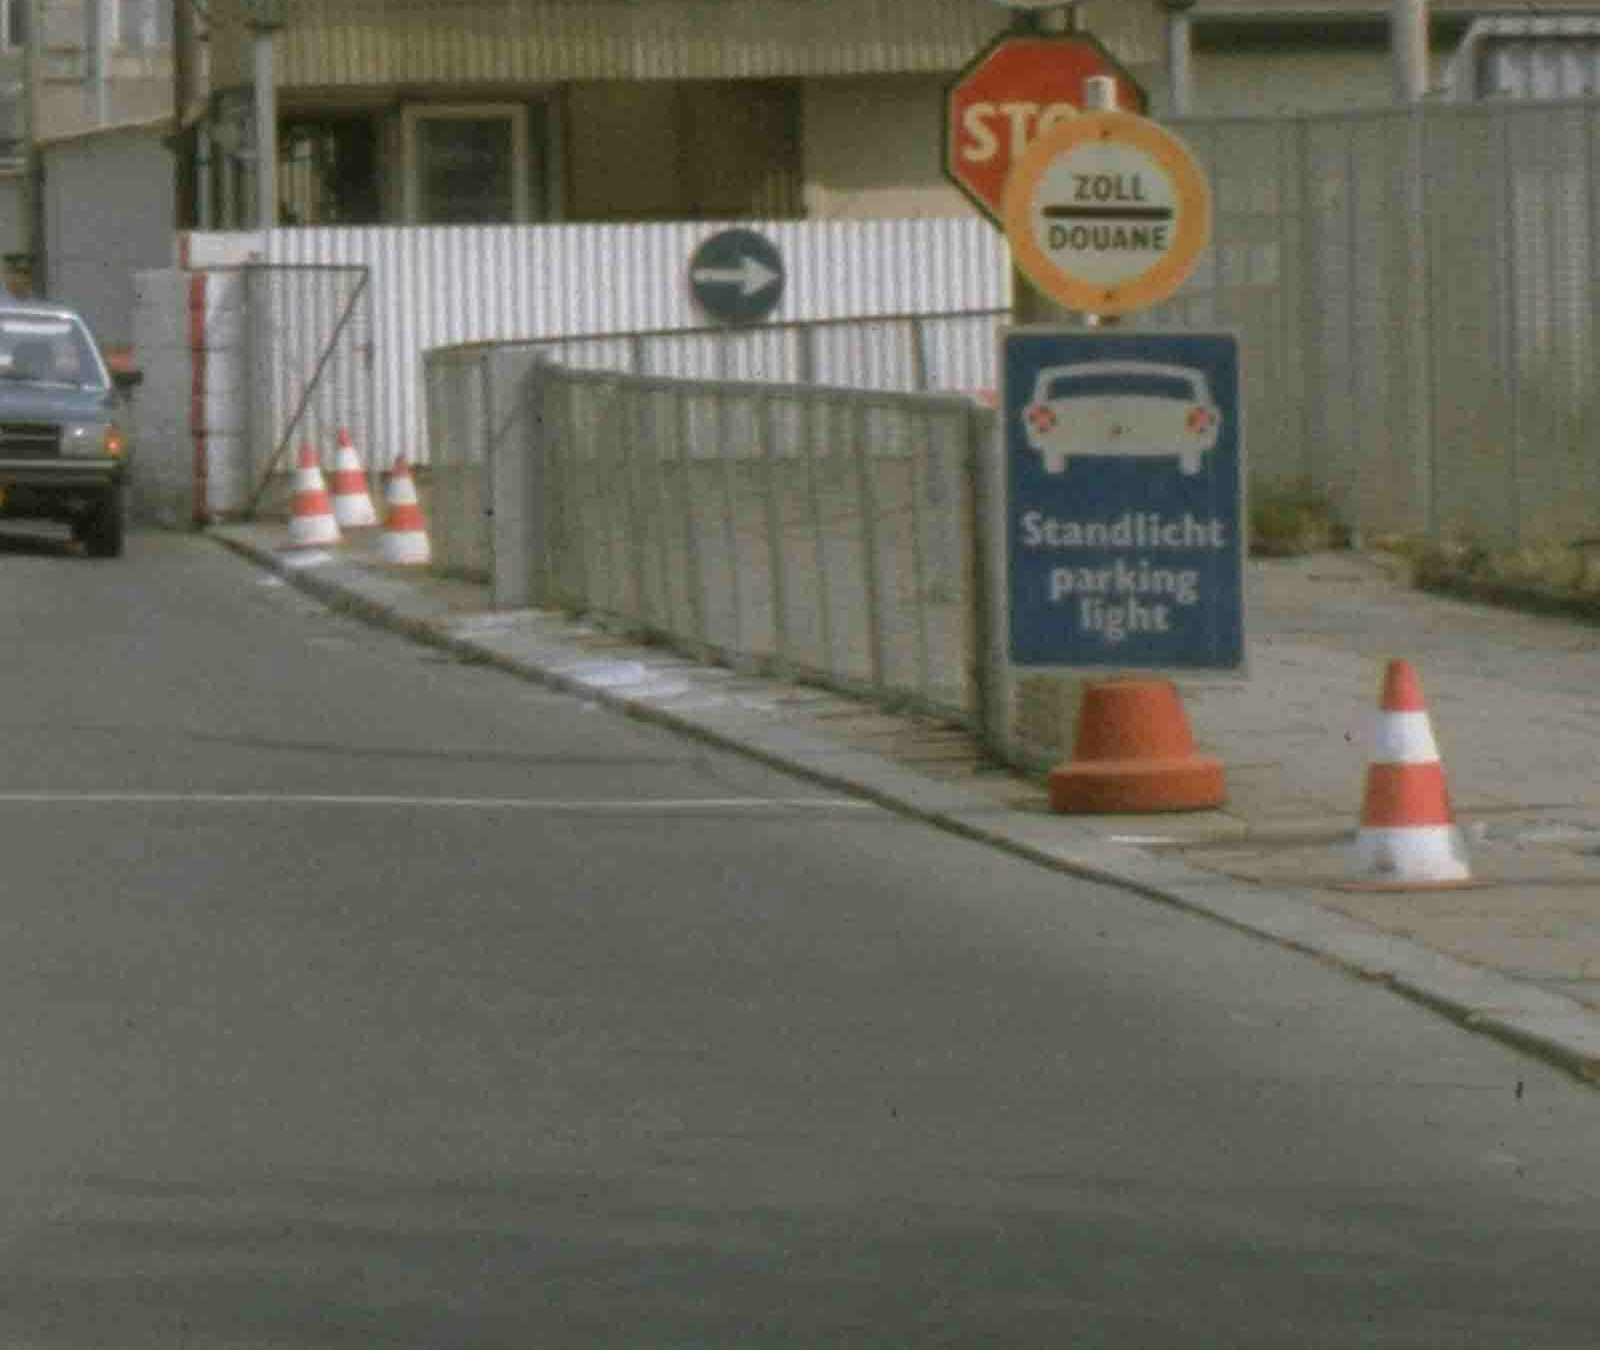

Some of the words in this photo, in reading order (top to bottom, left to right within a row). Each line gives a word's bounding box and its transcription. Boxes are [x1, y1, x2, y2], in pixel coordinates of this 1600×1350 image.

[962, 102, 1081, 162] ST
[1074, 175, 1146, 202] ZOLL
[1049, 225, 1168, 252] DOUANE
[1022, 511, 1225, 548] Standlicht
[1050, 559, 1199, 605] parking
[1080, 597, 1170, 642] light
